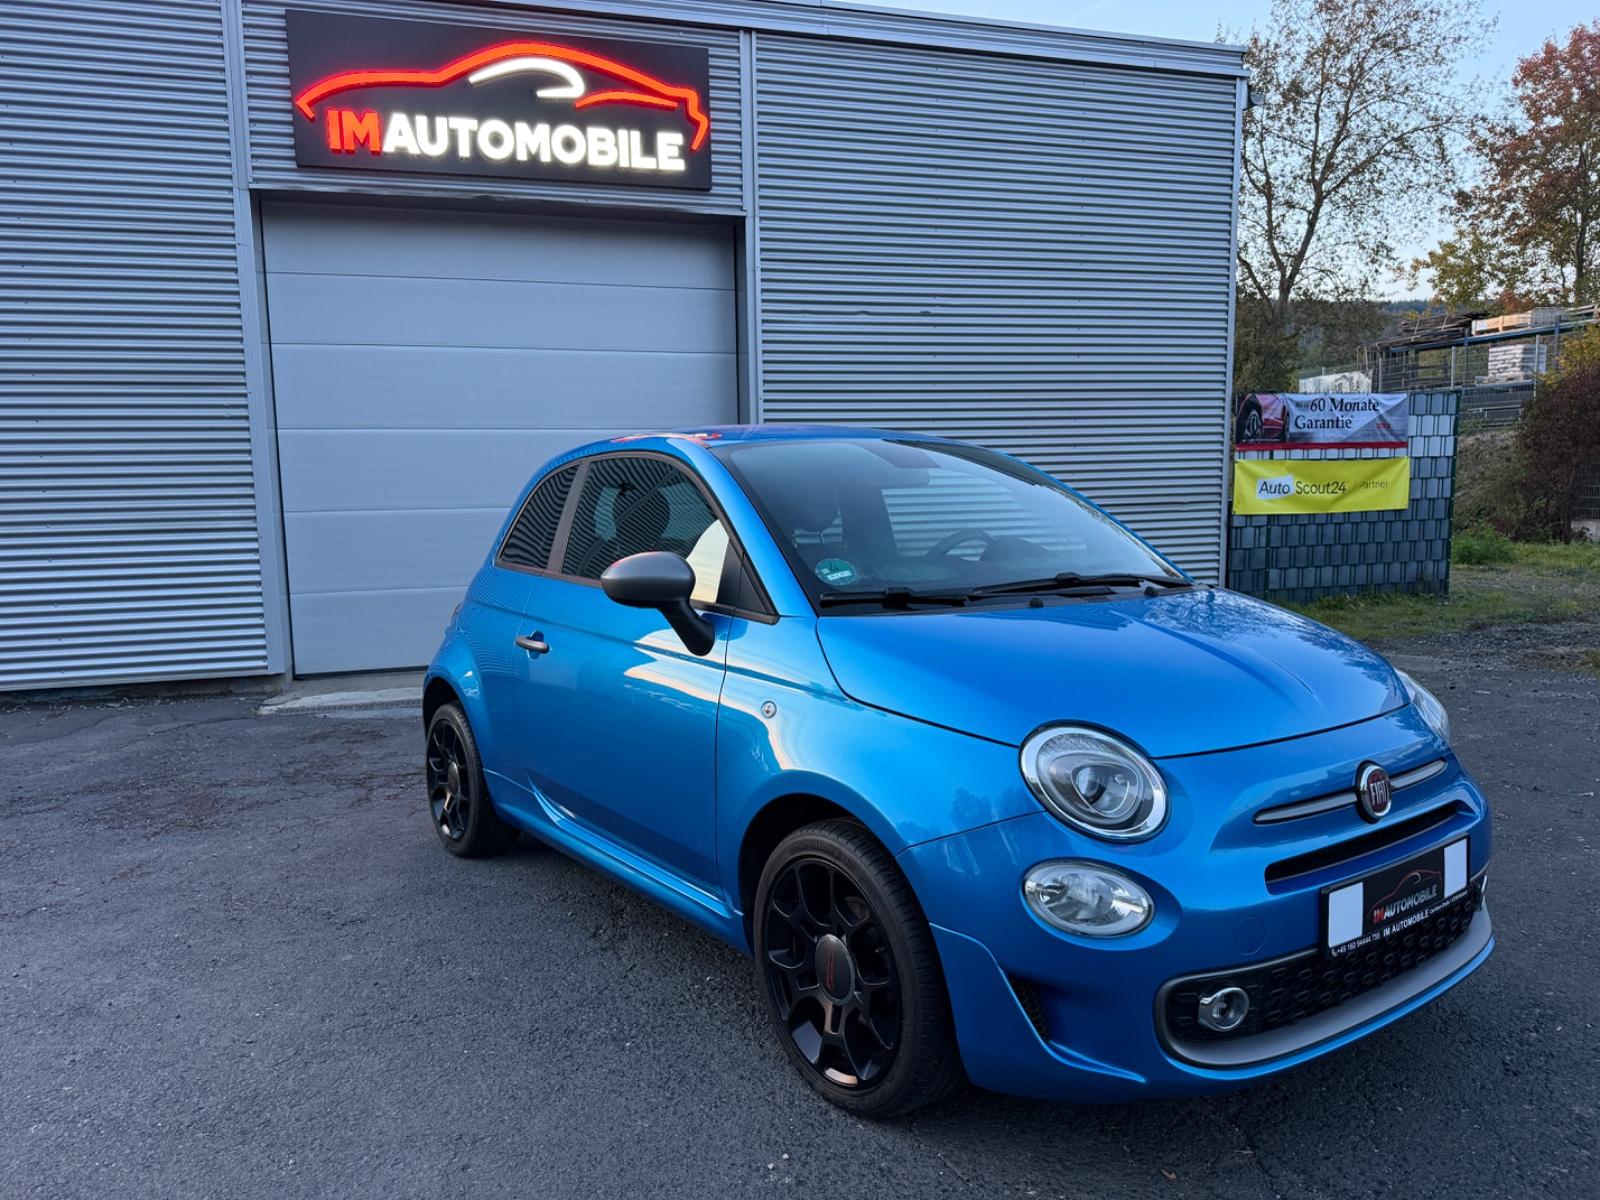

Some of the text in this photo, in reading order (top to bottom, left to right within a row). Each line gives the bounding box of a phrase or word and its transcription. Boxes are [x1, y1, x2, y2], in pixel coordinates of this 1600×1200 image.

[326, 108, 686, 172] IMAUTOMOBILE
[1310, 398, 1325, 412] 60
[1329, 397, 1380, 412] Monate
[1258, 481, 1291, 496] Auto
[1295, 480, 1346, 495] Scout24
[1369, 779, 1389, 805] FIAT
[1383, 926, 1391, 937] IM
[1391, 909, 1429, 934] AUTOMOBILE
